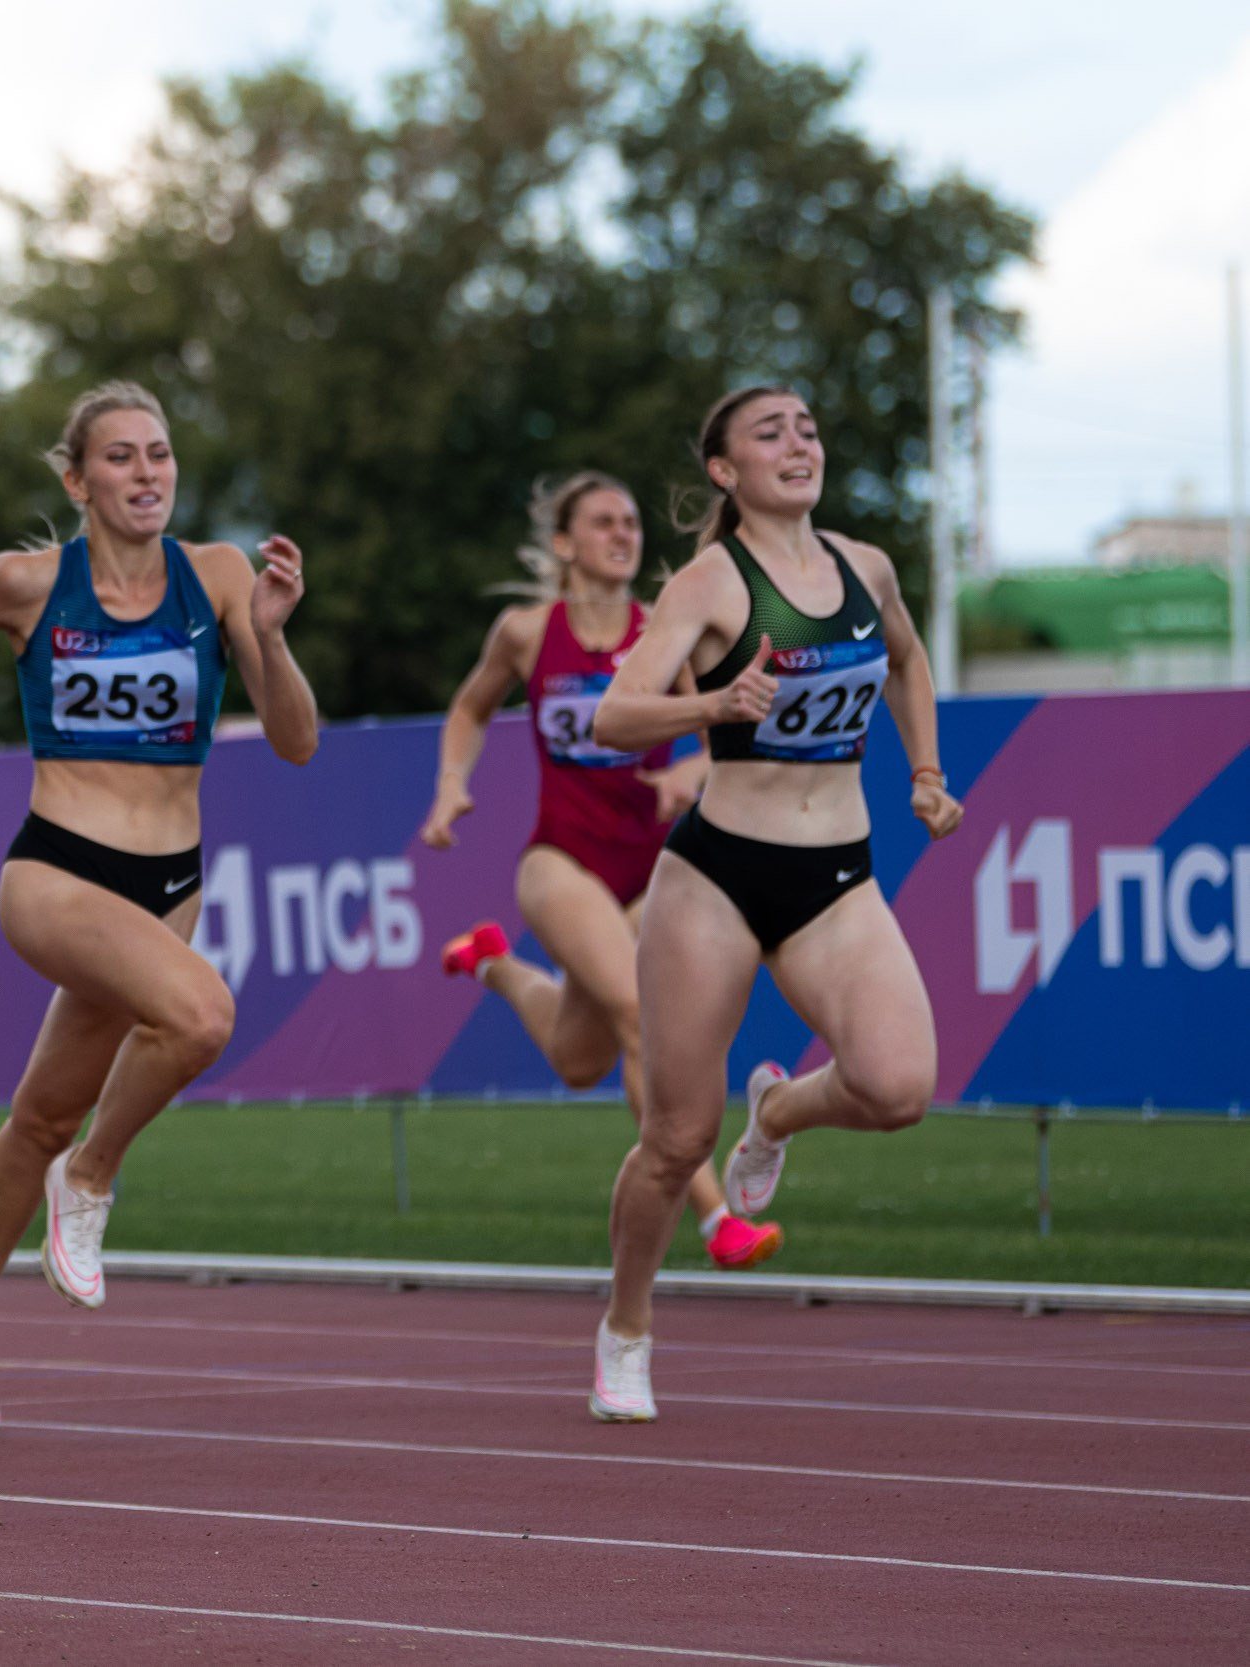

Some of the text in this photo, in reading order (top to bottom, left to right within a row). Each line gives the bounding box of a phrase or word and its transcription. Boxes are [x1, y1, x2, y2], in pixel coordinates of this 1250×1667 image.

[777, 646, 823, 669] U23
[64, 672, 180, 721] 253
[776, 682, 877, 737] 622
[267, 858, 423, 977] ПСБ
